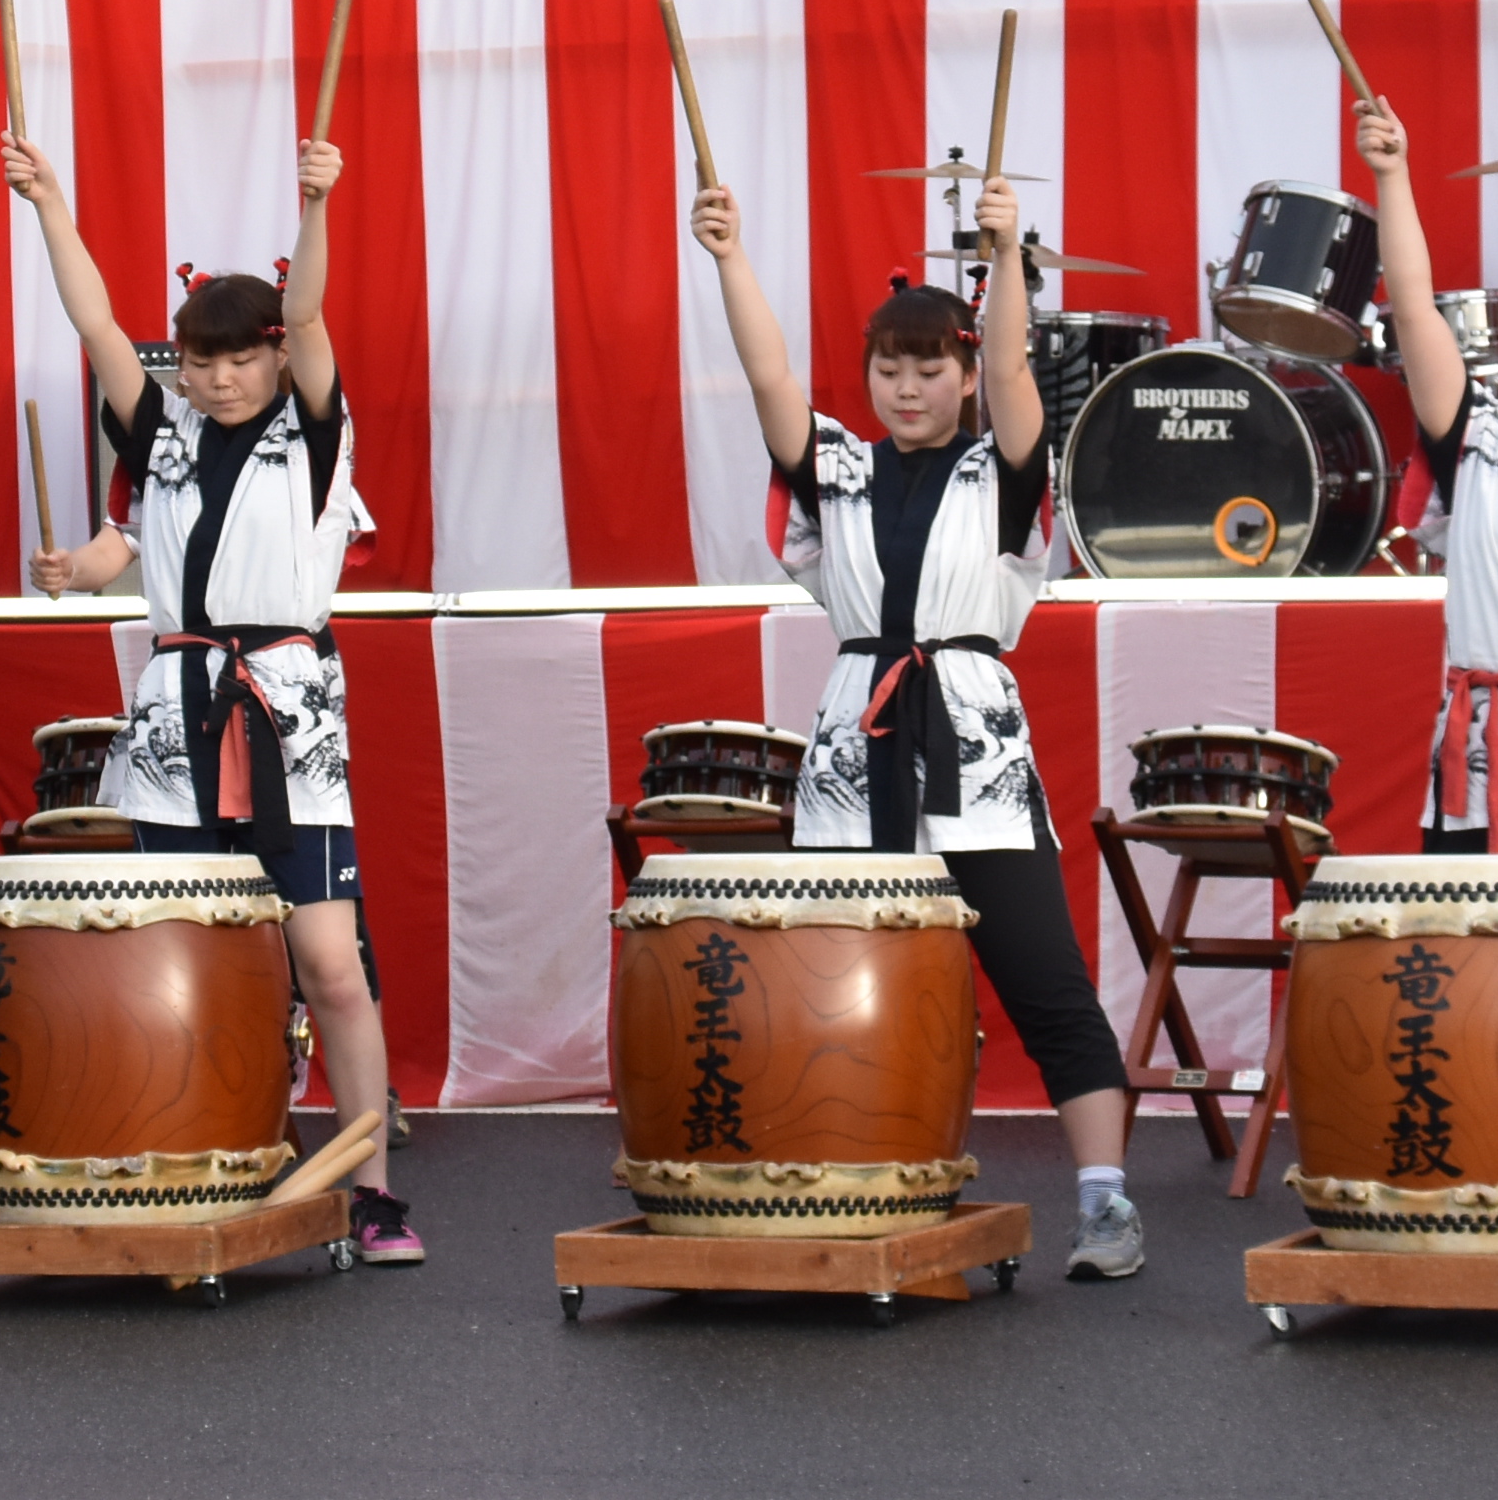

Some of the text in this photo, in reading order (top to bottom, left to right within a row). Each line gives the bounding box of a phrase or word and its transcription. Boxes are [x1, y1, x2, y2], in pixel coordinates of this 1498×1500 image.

[1133, 388, 1250, 410] BROTHERS
[1157, 419, 1233, 441] MAPEX
[682, 933, 752, 1153] 竜王太鼓
[1383, 943, 1464, 1178] 竜王太鼓
